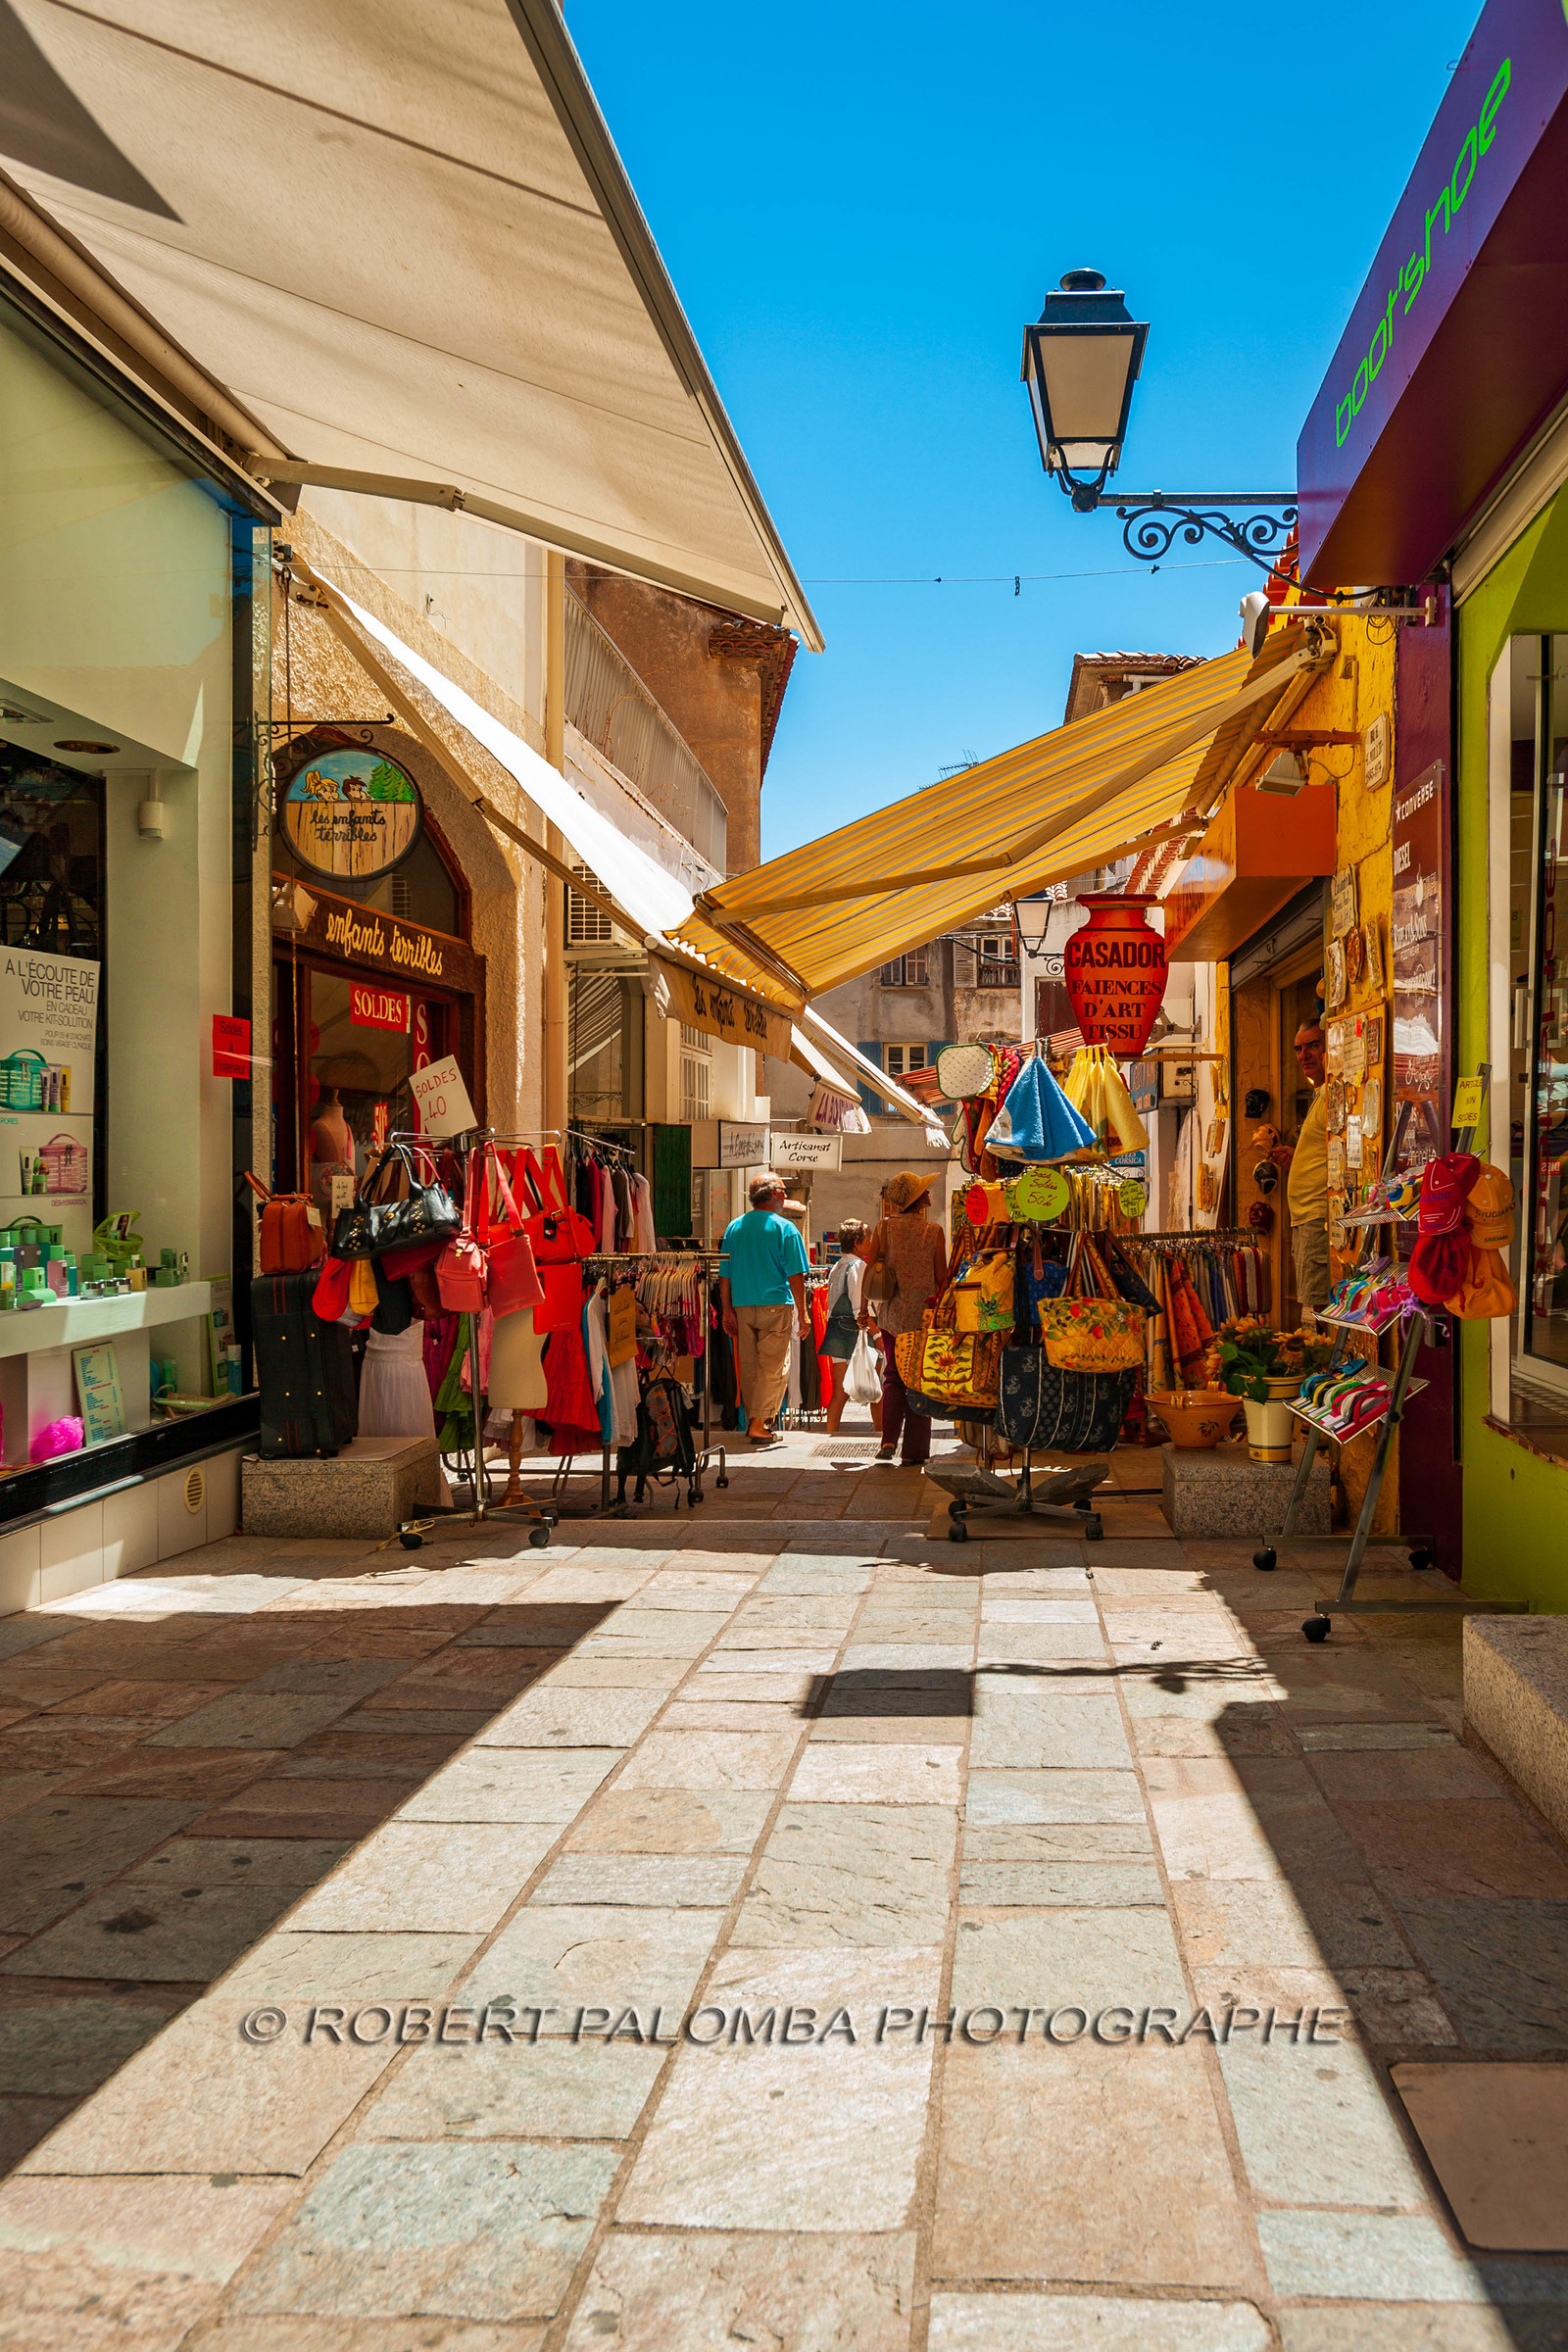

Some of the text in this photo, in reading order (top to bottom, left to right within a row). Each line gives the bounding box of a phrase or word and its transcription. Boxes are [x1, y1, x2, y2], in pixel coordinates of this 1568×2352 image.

[1401, 780, 1434, 821] CONVERSE
[310, 808, 386, 826] les enfants
[1394, 840, 1411, 876] DIESEL
[325, 908, 443, 976] enfants terribles
[1067, 942, 1166, 968] CASADOR
[5, 958, 95, 988] A L'ÉCOUTE DE
[22, 978, 95, 1004] VOTRE PEAU.
[1071, 980, 1162, 996] FAIENCES
[46, 1001, 57, 1012] EN
[354, 990, 402, 1023] SOLDES
[1083, 999, 1147, 1018] D'ART
[18, 1009, 93, 1029] VOTRE KIT-SOLUTION
[220, 1020, 243, 1037] Soldes
[1084, 1024, 1142, 1040] TISSU
[416, 1068, 457, 1099] SOLDES
[779, 1140, 831, 1152] Artisanat
[788, 1152, 818, 1163] Corse
[1027, 1191, 1057, 1206] 50%
